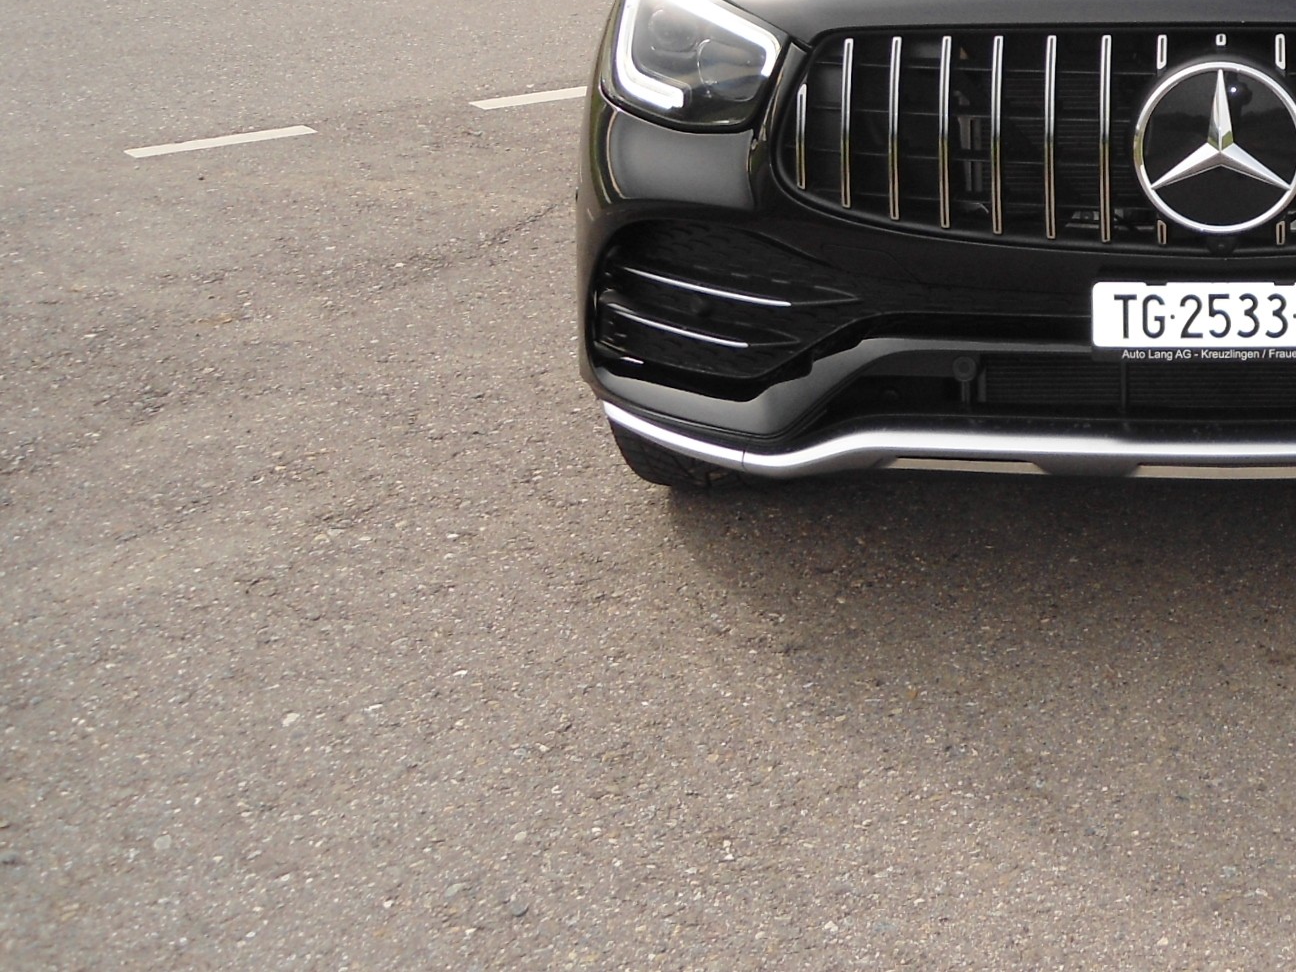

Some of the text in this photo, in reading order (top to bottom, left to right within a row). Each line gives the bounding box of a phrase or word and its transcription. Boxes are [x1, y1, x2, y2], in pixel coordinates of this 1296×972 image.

[1121, 349, 1146, 359] Auto
[1148, 349, 1173, 361] Lang
[1175, 349, 1192, 359] AG
[1201, 349, 1260, 361] Kreuzlingen
